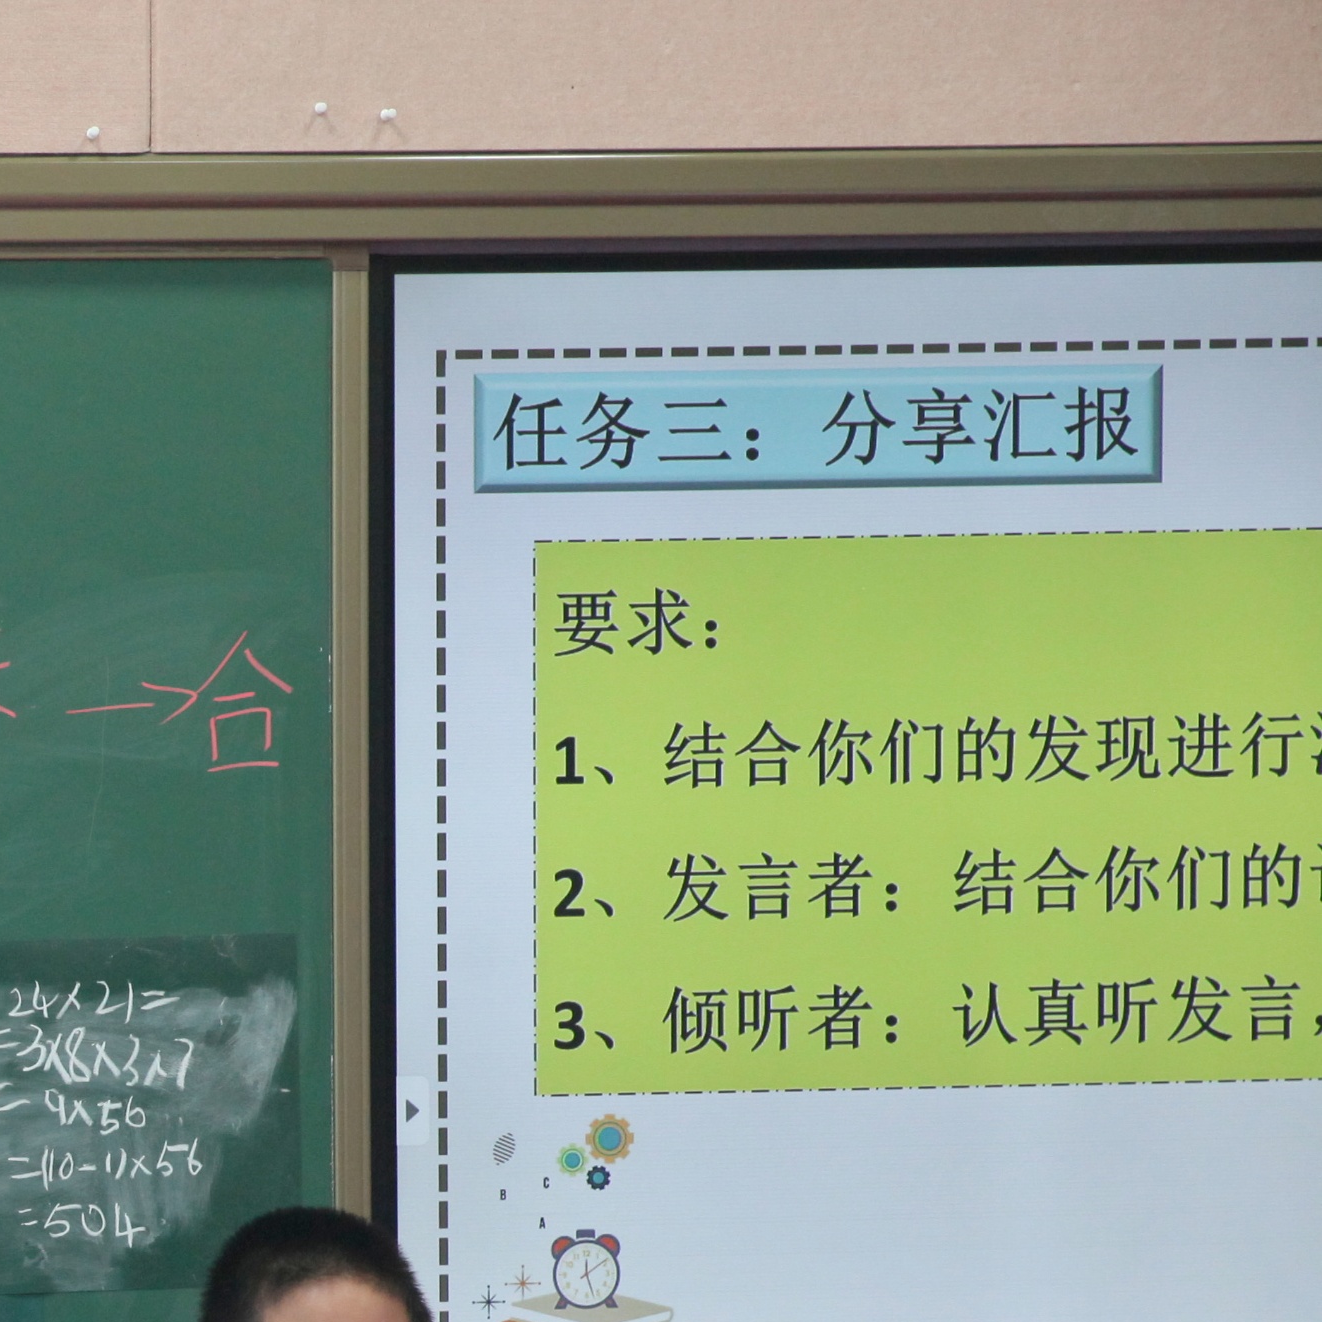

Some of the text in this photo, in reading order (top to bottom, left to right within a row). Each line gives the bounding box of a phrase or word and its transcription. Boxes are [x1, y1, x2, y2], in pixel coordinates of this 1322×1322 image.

[492, 386, 1140, 472] 任务三：分享汇报
[553, 587, 719, 658] 要求：
[193, 631, 293, 773] 合
[553, 843, 1322, 923] 2、发言者：结合你们的
[500, 1189, 507, 1201] B
[543, 1177, 550, 1189] C
[18, 1202, 146, 1248] =504
[539, 1217, 546, 1229] A
